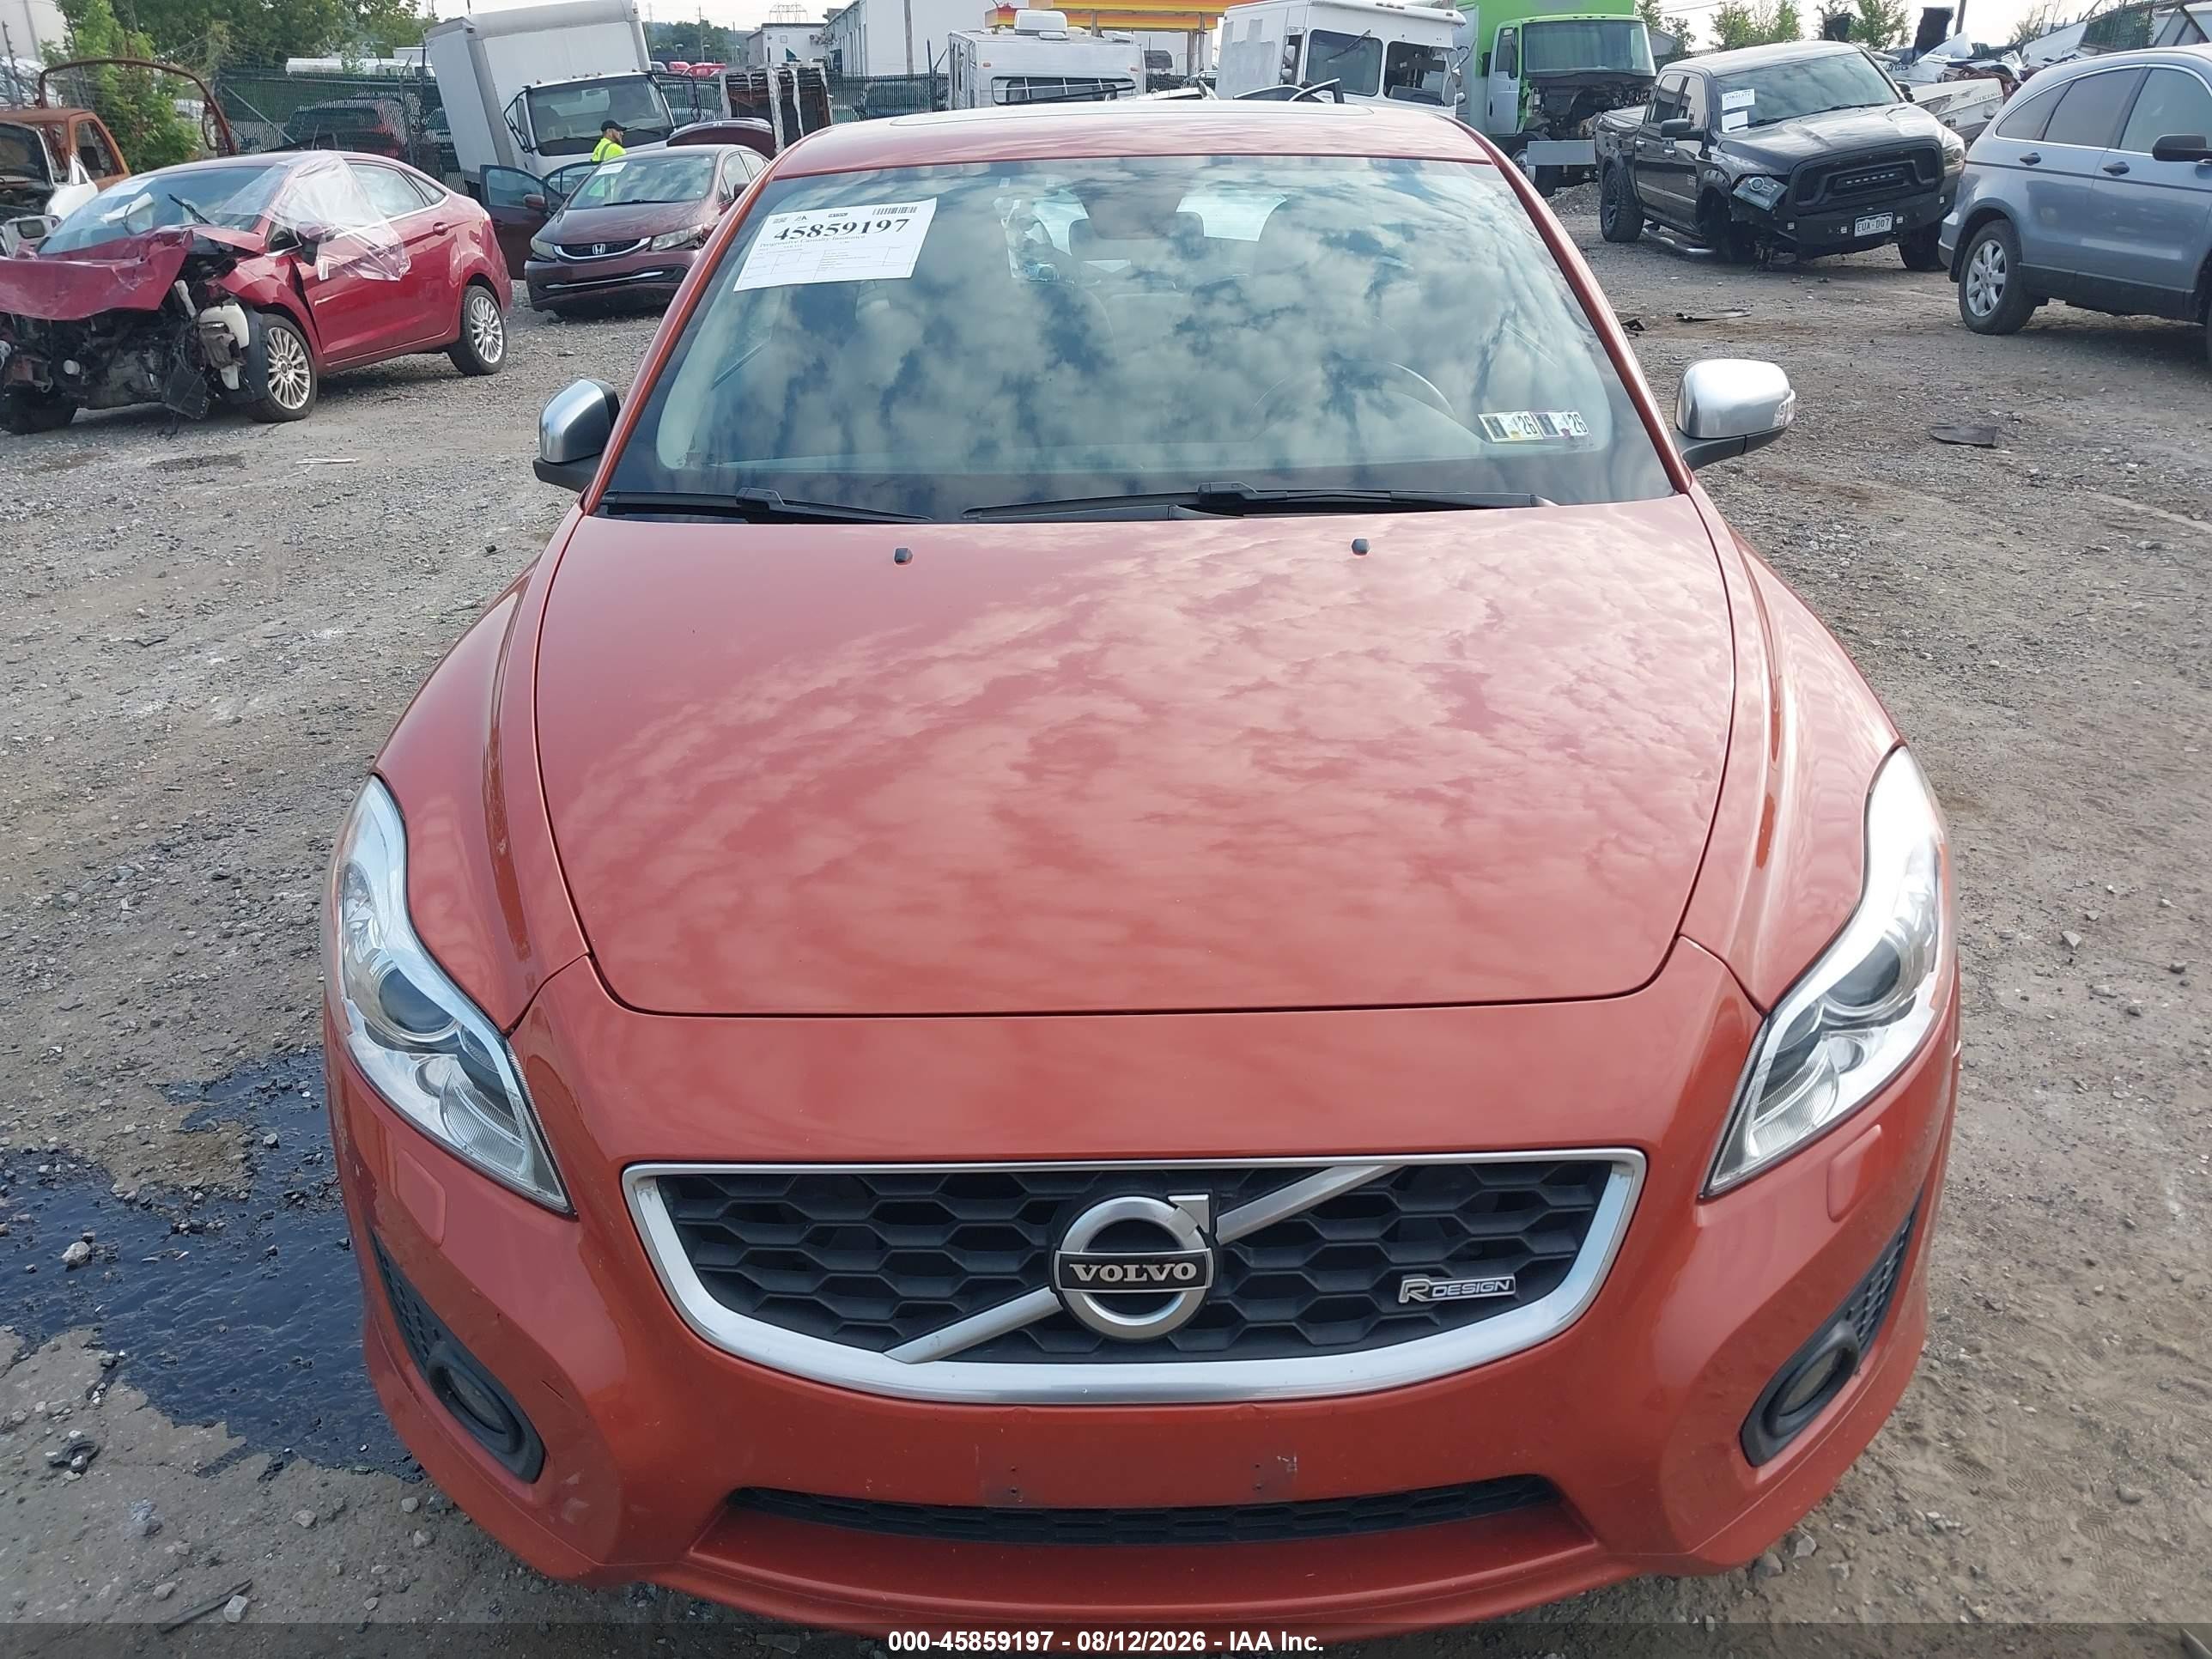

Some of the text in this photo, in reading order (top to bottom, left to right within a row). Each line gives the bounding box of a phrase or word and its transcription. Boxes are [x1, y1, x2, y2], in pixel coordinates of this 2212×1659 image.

[774, 218, 910, 240] 45859197
[1518, 415, 1538, 435] 26
[1568, 413, 1588, 434] 26
[1069, 1262, 1197, 1282] VOLVO
[1398, 1278, 1511, 1304] R DESIGN
